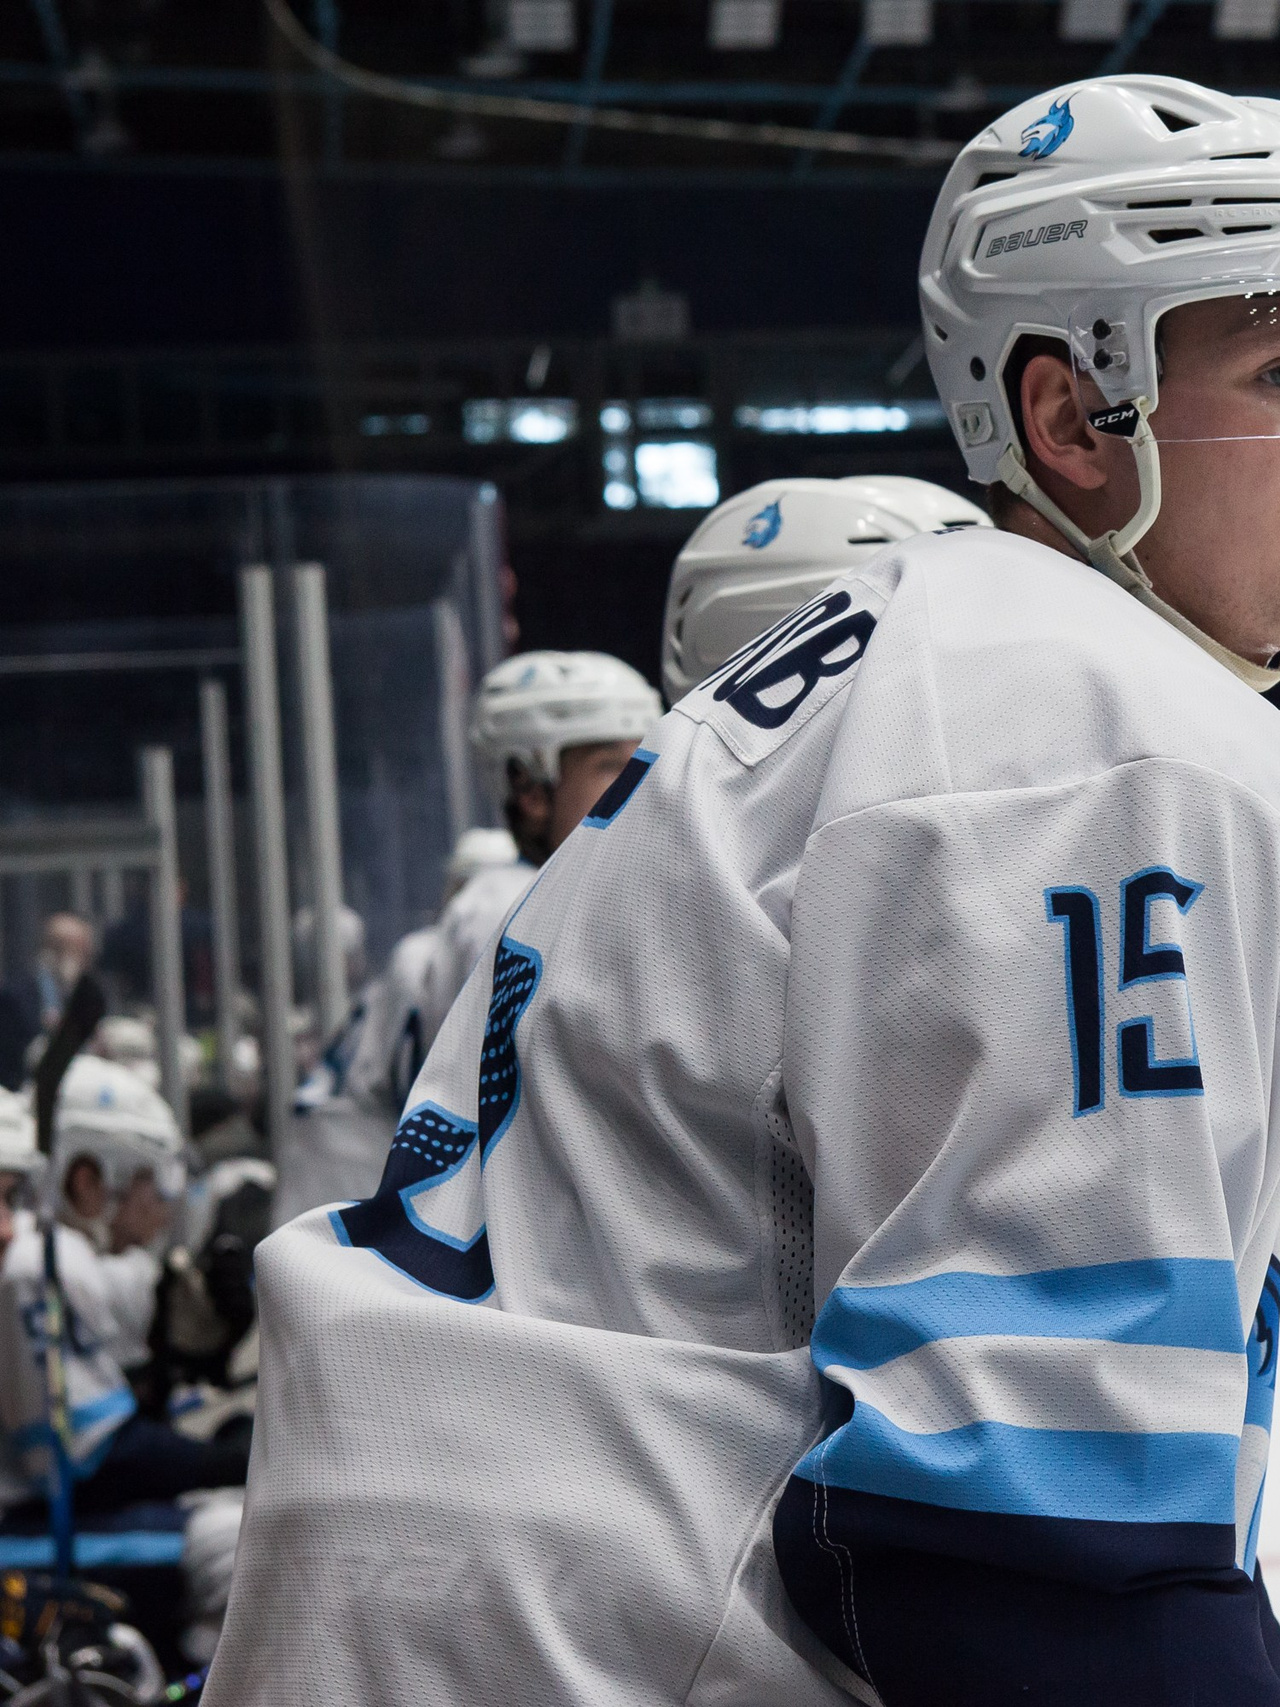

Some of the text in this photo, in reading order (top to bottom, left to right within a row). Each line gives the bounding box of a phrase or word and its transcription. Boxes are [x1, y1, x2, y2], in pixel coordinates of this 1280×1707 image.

[986, 219, 1088, 258] BAUER
[1093, 408, 1135, 427] CCM
[697, 588, 877, 730] ОВ
[1043, 864, 1205, 1119] 15
